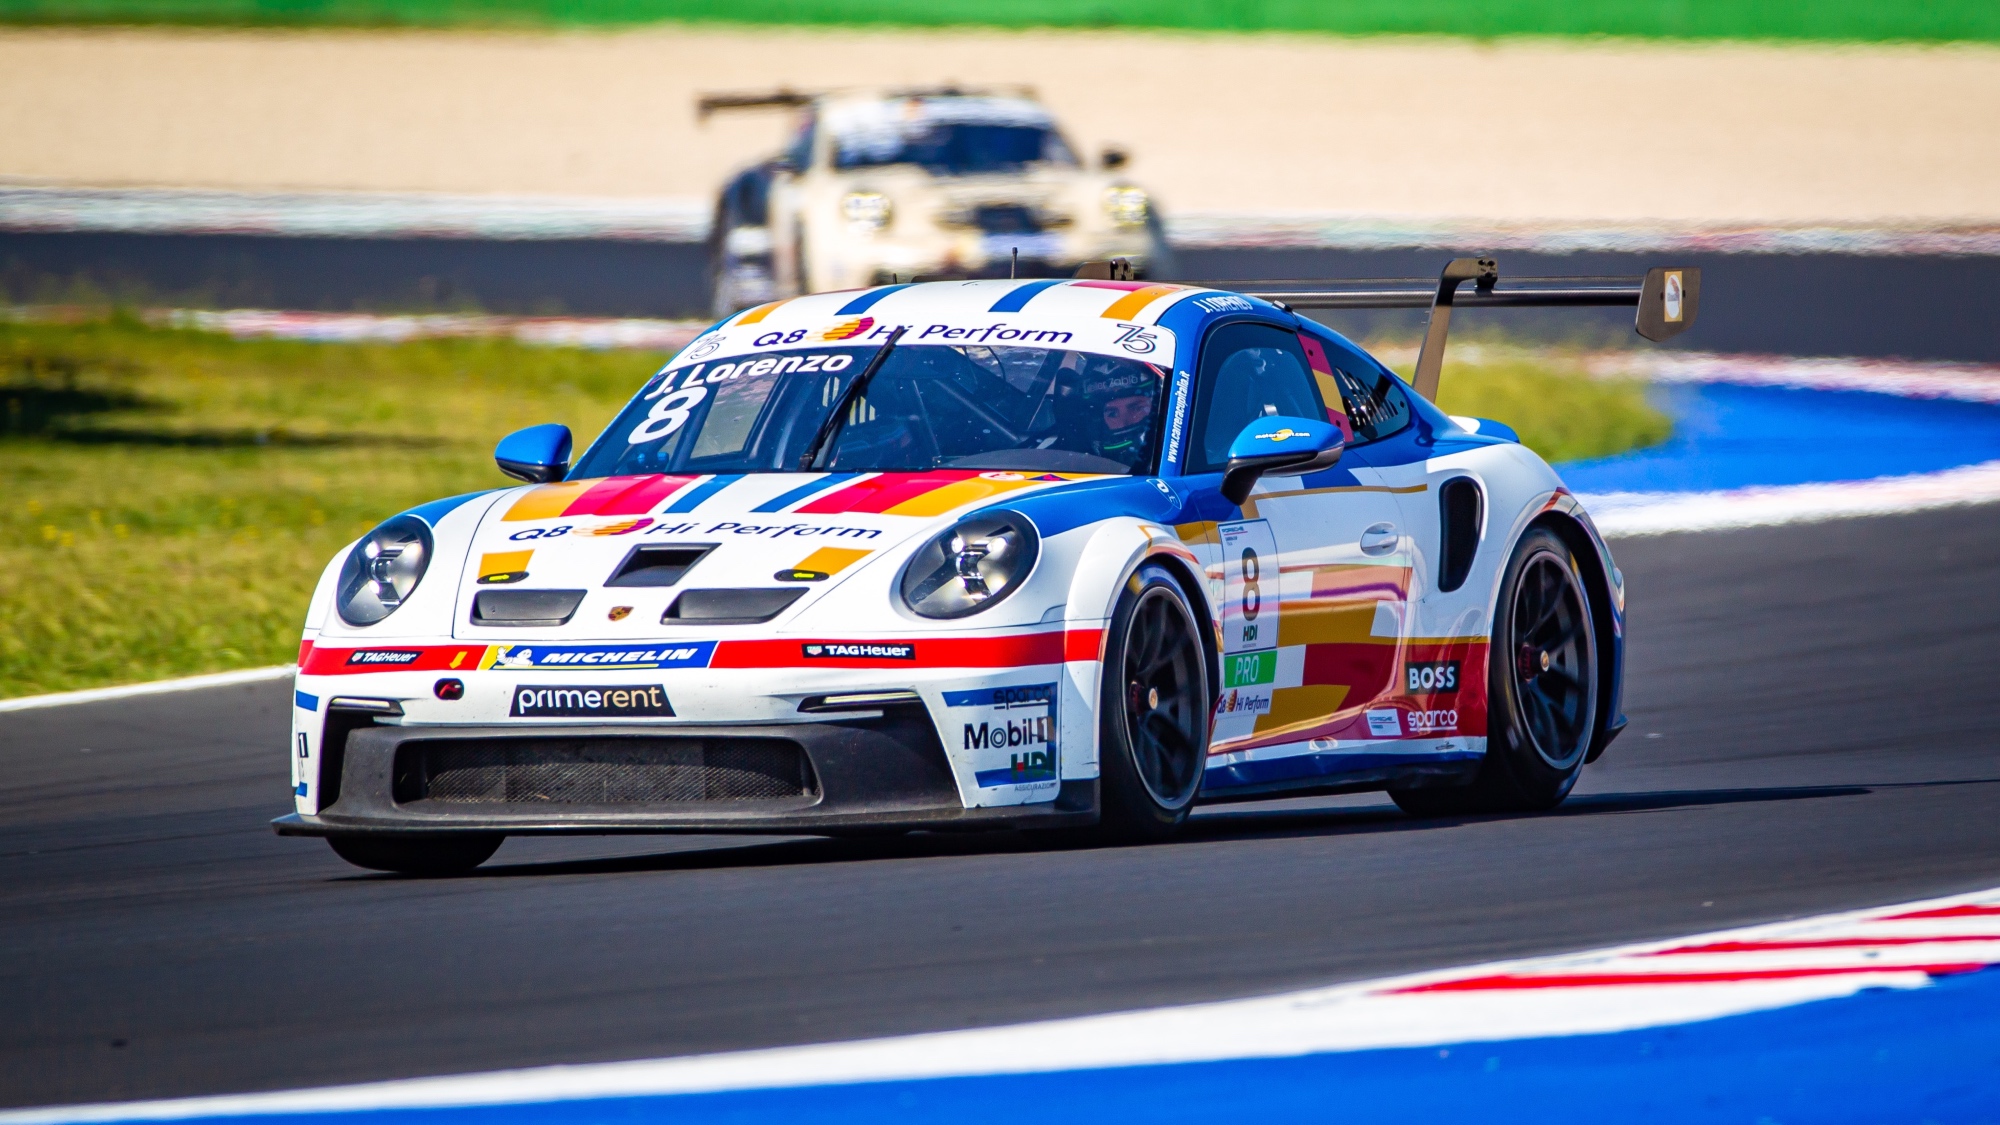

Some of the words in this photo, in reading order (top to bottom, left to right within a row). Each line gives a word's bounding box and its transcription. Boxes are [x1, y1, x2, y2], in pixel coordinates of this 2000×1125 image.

[753, 329, 808, 347] Q8
[918, 324, 1073, 344] Perform
[1113, 323, 1158, 354] 75
[680, 354, 853, 389] Lorenzo
[628, 386, 708, 445] 8
[508, 525, 573, 541] Q8
[644, 522, 700, 535] Hi
[705, 521, 882, 540] Perform
[1242, 547, 1260, 621] 8
[1243, 625, 1258, 642] HDI
[541, 648, 698, 664] MICHELIN
[1234, 655, 1259, 685] PRO
[1408, 666, 1455, 690] BOSS
[518, 687, 662, 714] primerent
[993, 686, 1053, 710] sparco
[1244, 695, 1269, 713] Perform
[1407, 709, 1458, 731] sparco
